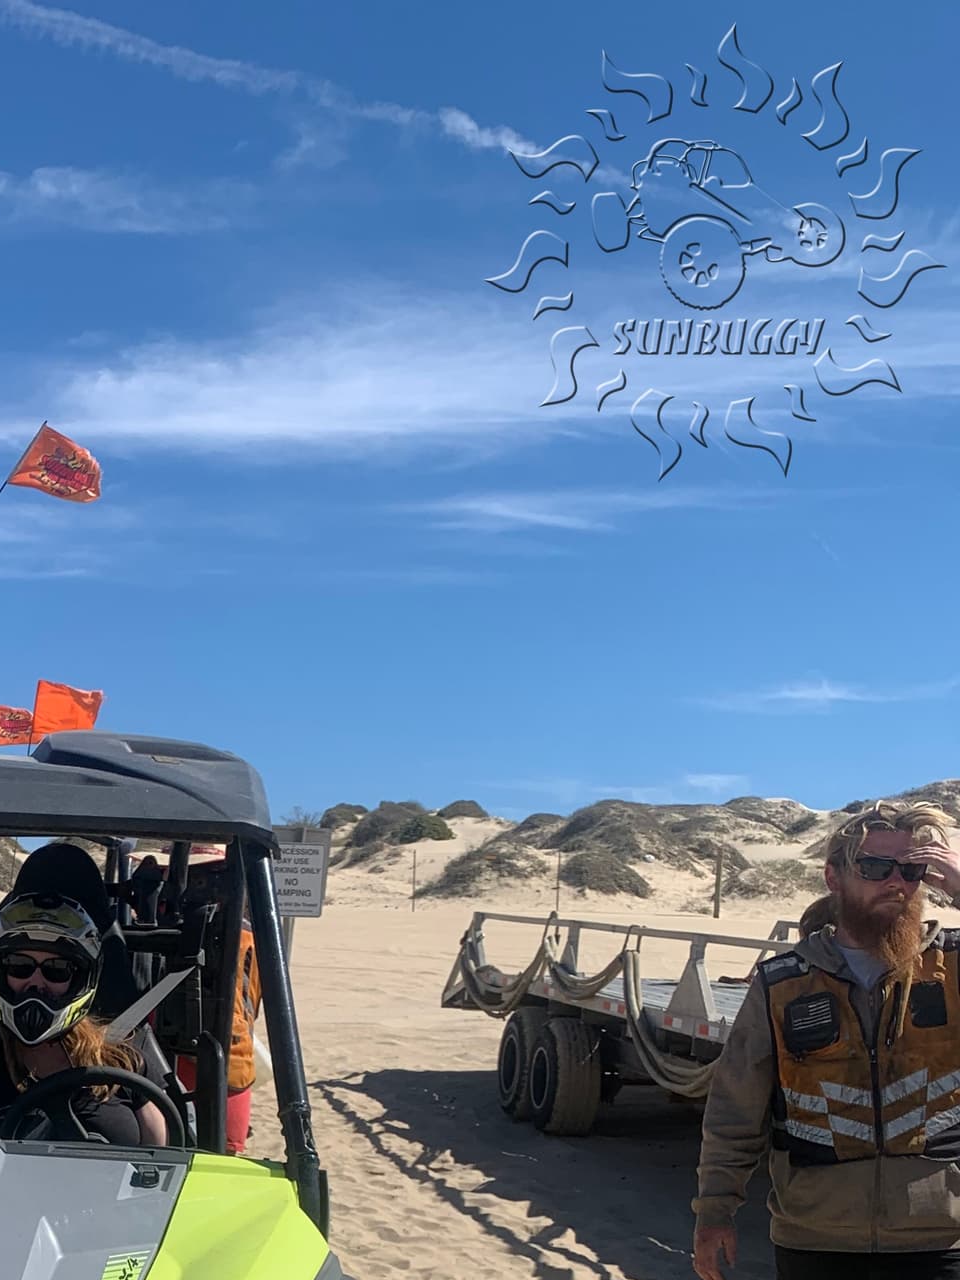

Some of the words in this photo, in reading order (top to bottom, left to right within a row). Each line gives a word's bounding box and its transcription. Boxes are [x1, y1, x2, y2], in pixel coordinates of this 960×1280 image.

[274, 866, 298, 874] RKING
[284, 878, 298, 886] NO
[277, 888, 311, 897] AMPING
